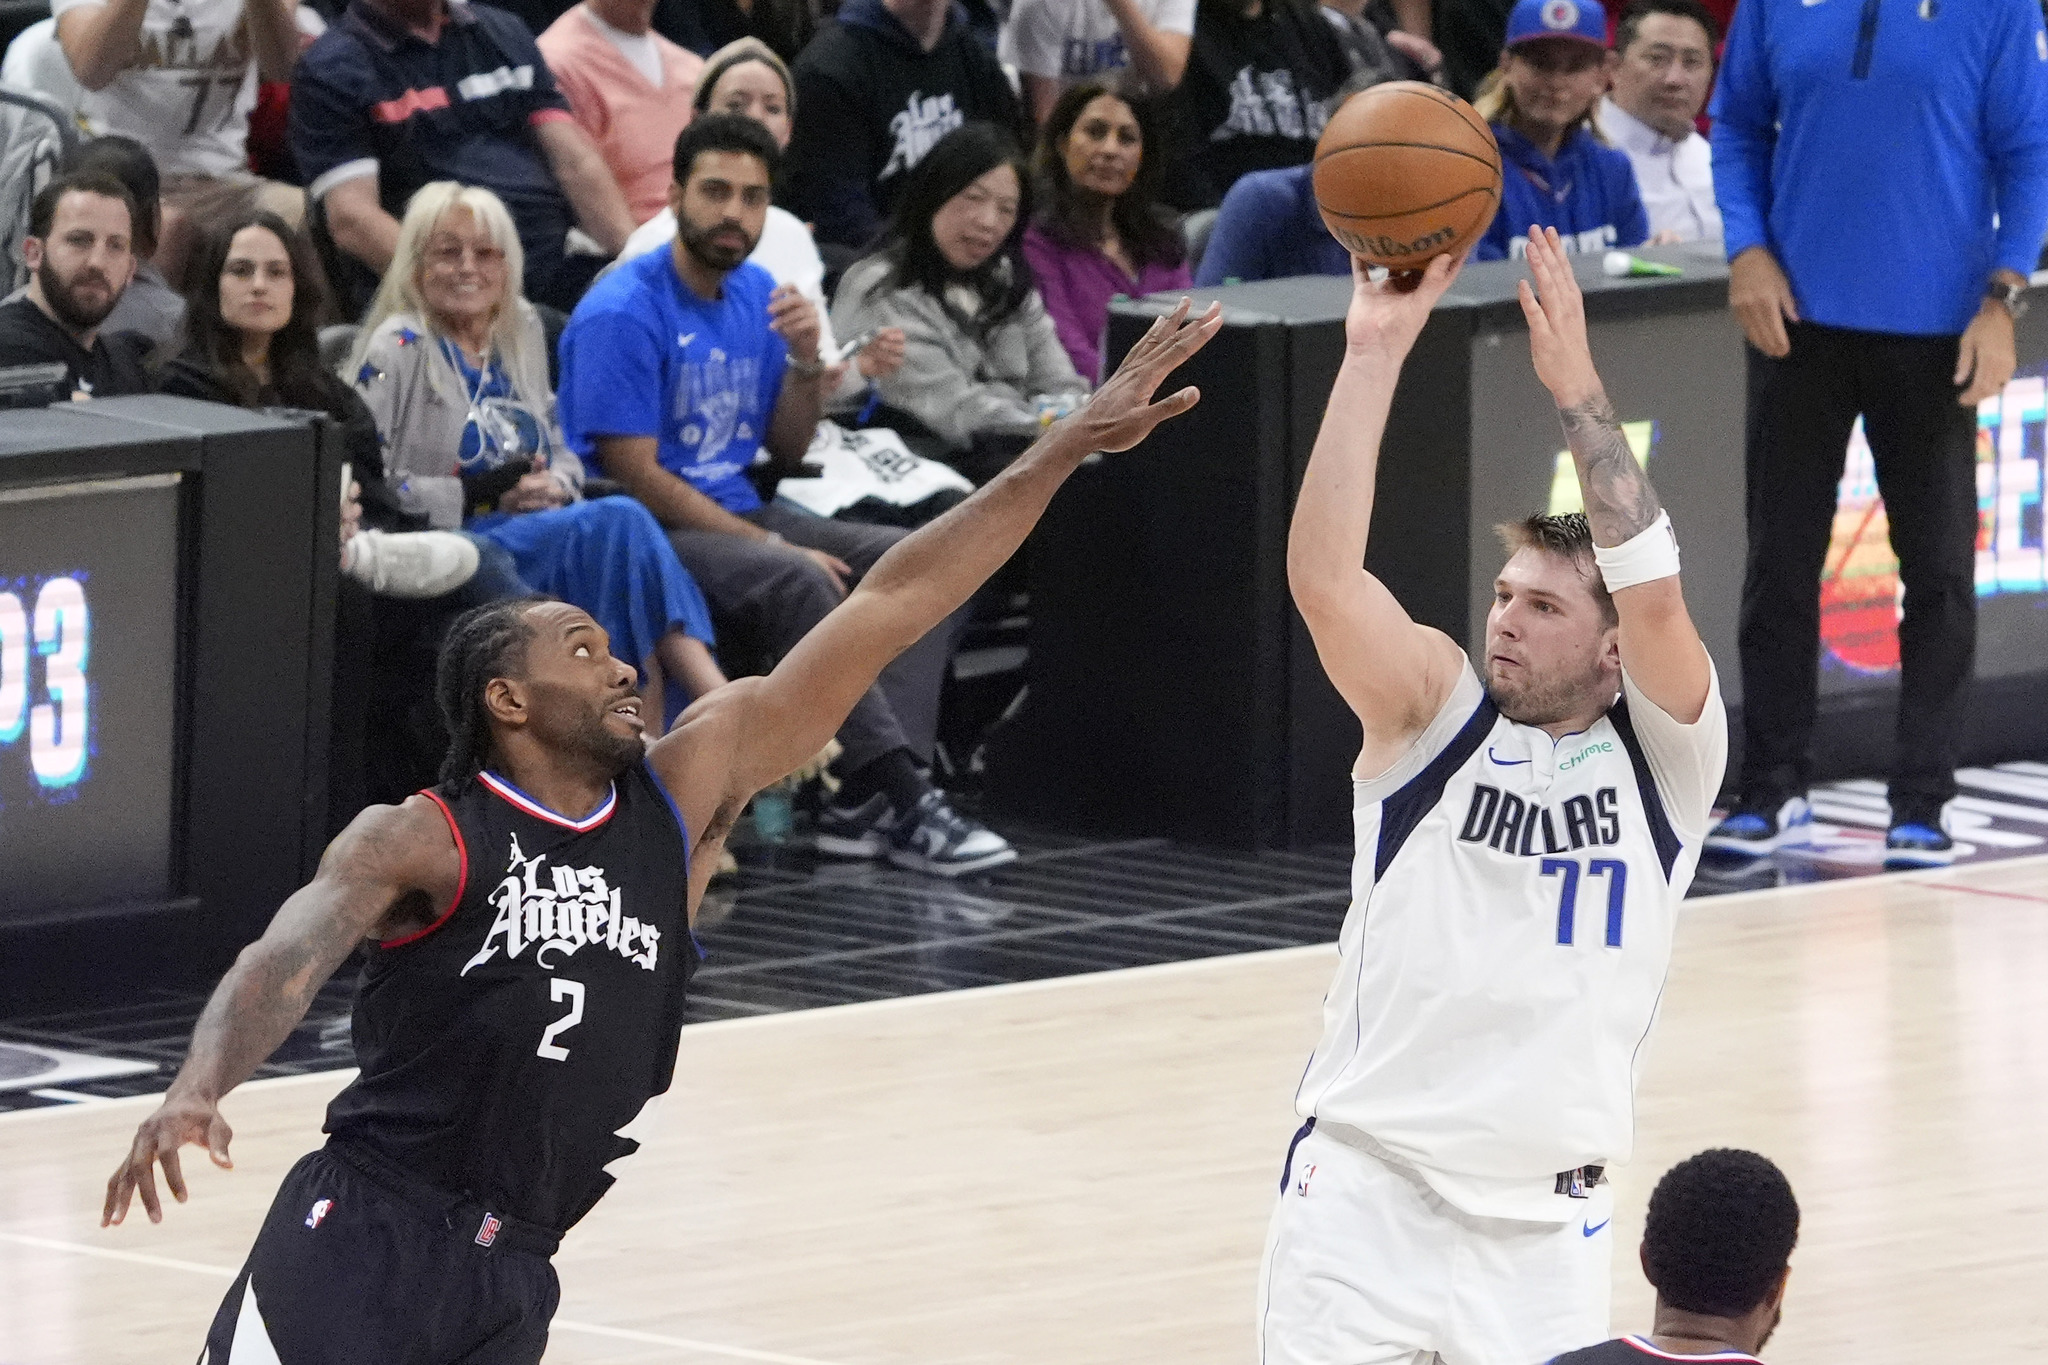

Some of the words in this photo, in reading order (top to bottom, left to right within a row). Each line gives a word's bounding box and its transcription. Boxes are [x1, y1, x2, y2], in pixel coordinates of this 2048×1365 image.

[1332, 226, 1455, 257] Wilson
[1559, 741, 1614, 771] chime
[1457, 782, 1621, 857] DALLAS
[521, 853, 610, 903] Los
[1539, 857, 1629, 949] 77
[460, 876, 662, 977] Angeles
[536, 977, 586, 1062] 2
